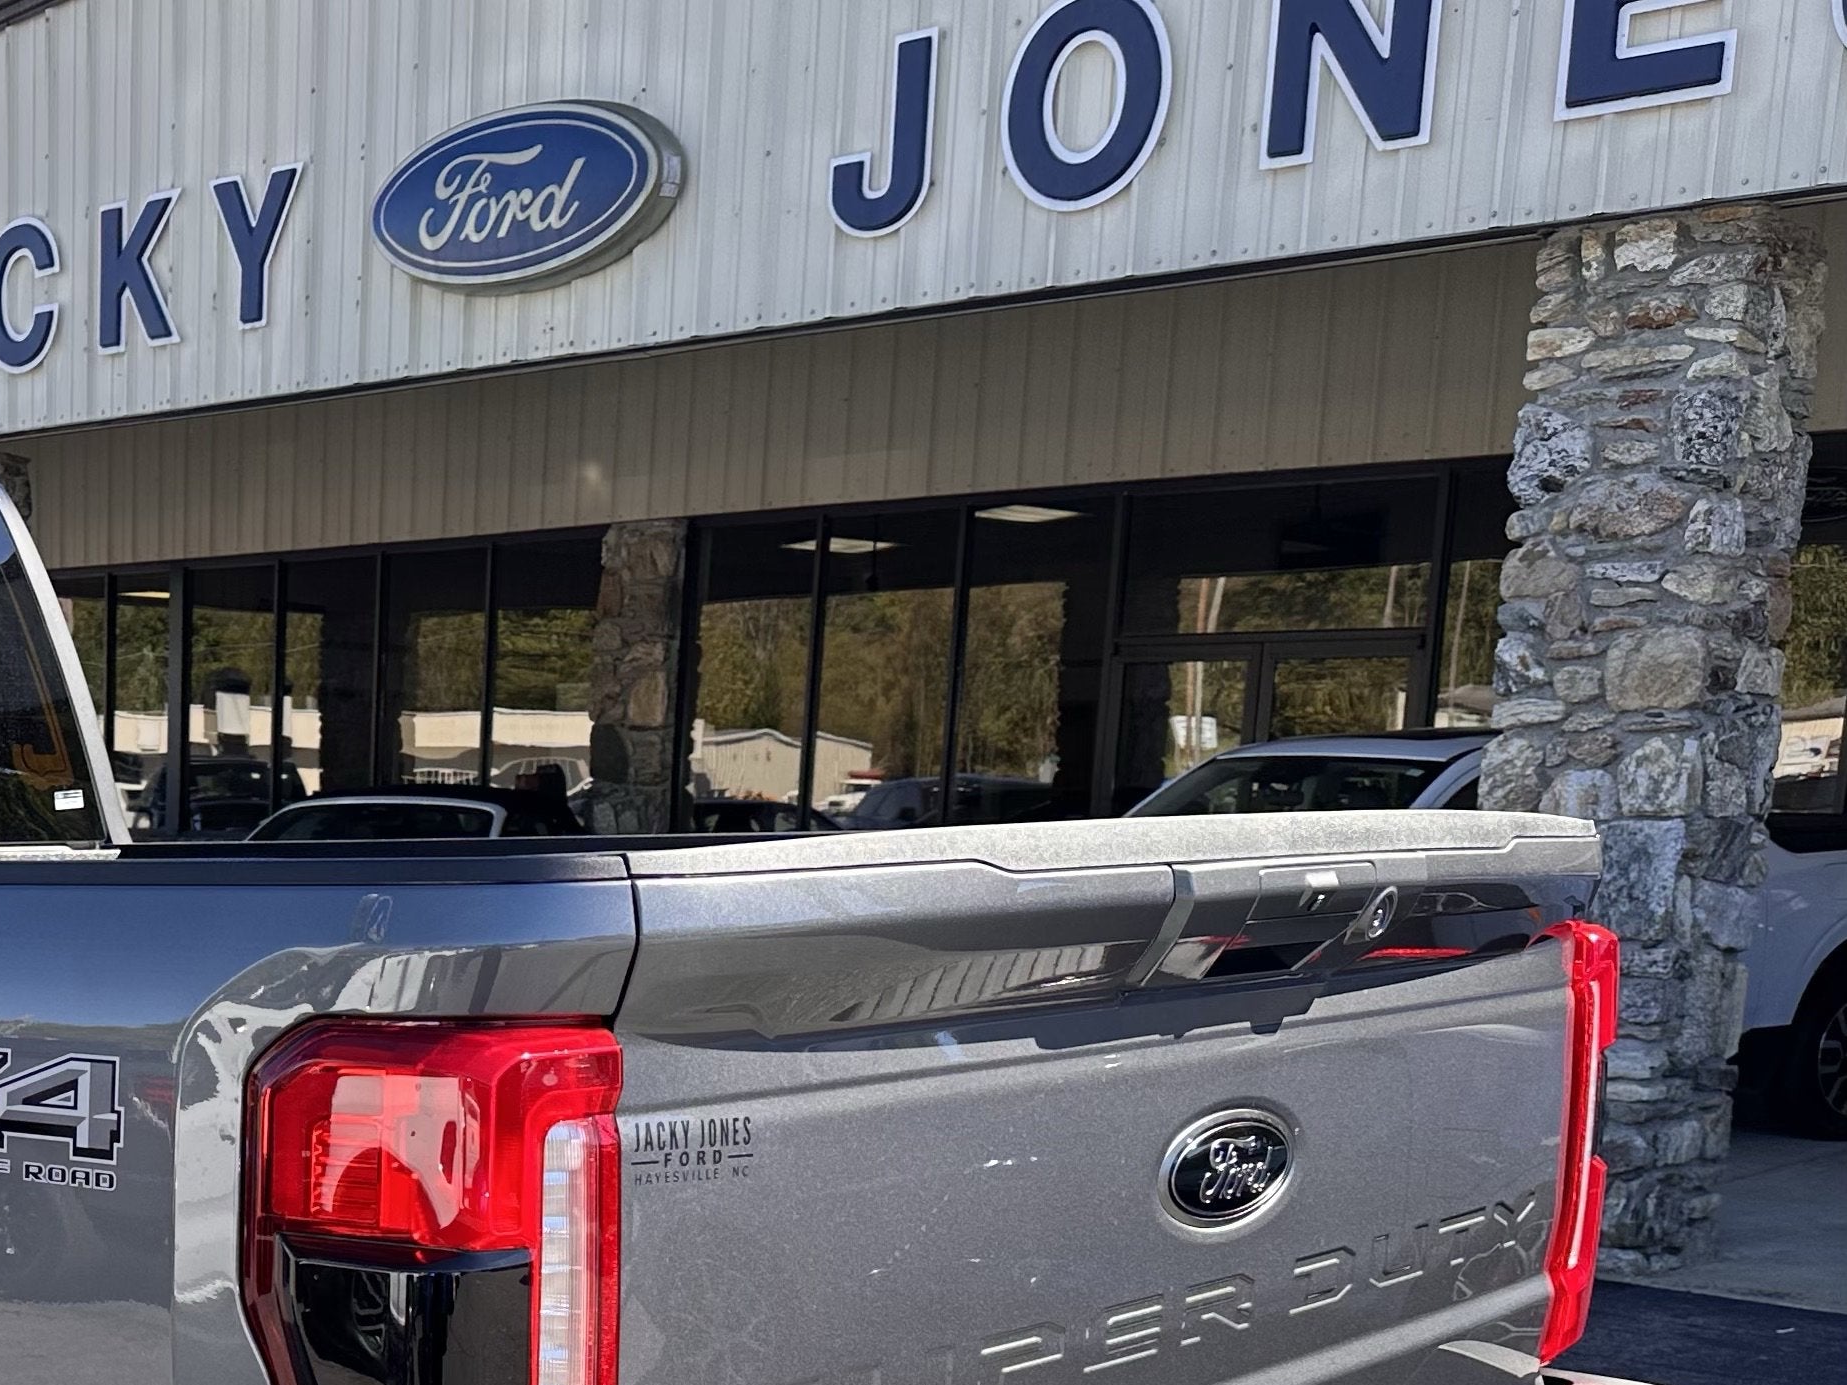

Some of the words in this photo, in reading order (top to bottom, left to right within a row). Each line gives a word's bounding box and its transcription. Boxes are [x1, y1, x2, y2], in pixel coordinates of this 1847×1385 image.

[829, 0, 1847, 238] JONE
[418, 143, 586, 252] Ford
[634, 1119, 690, 1152] JACKY
[700, 1116, 752, 1148] JONES
[664, 1149, 723, 1168] FORD
[23, 1164, 117, 1191] ROAD
[634, 1168, 720, 1186] HAYESVILLE
[732, 1165, 750, 1178] NC
[1200, 1136, 1274, 1203] Ford
[1288, 1198, 1537, 1316] DUTY
